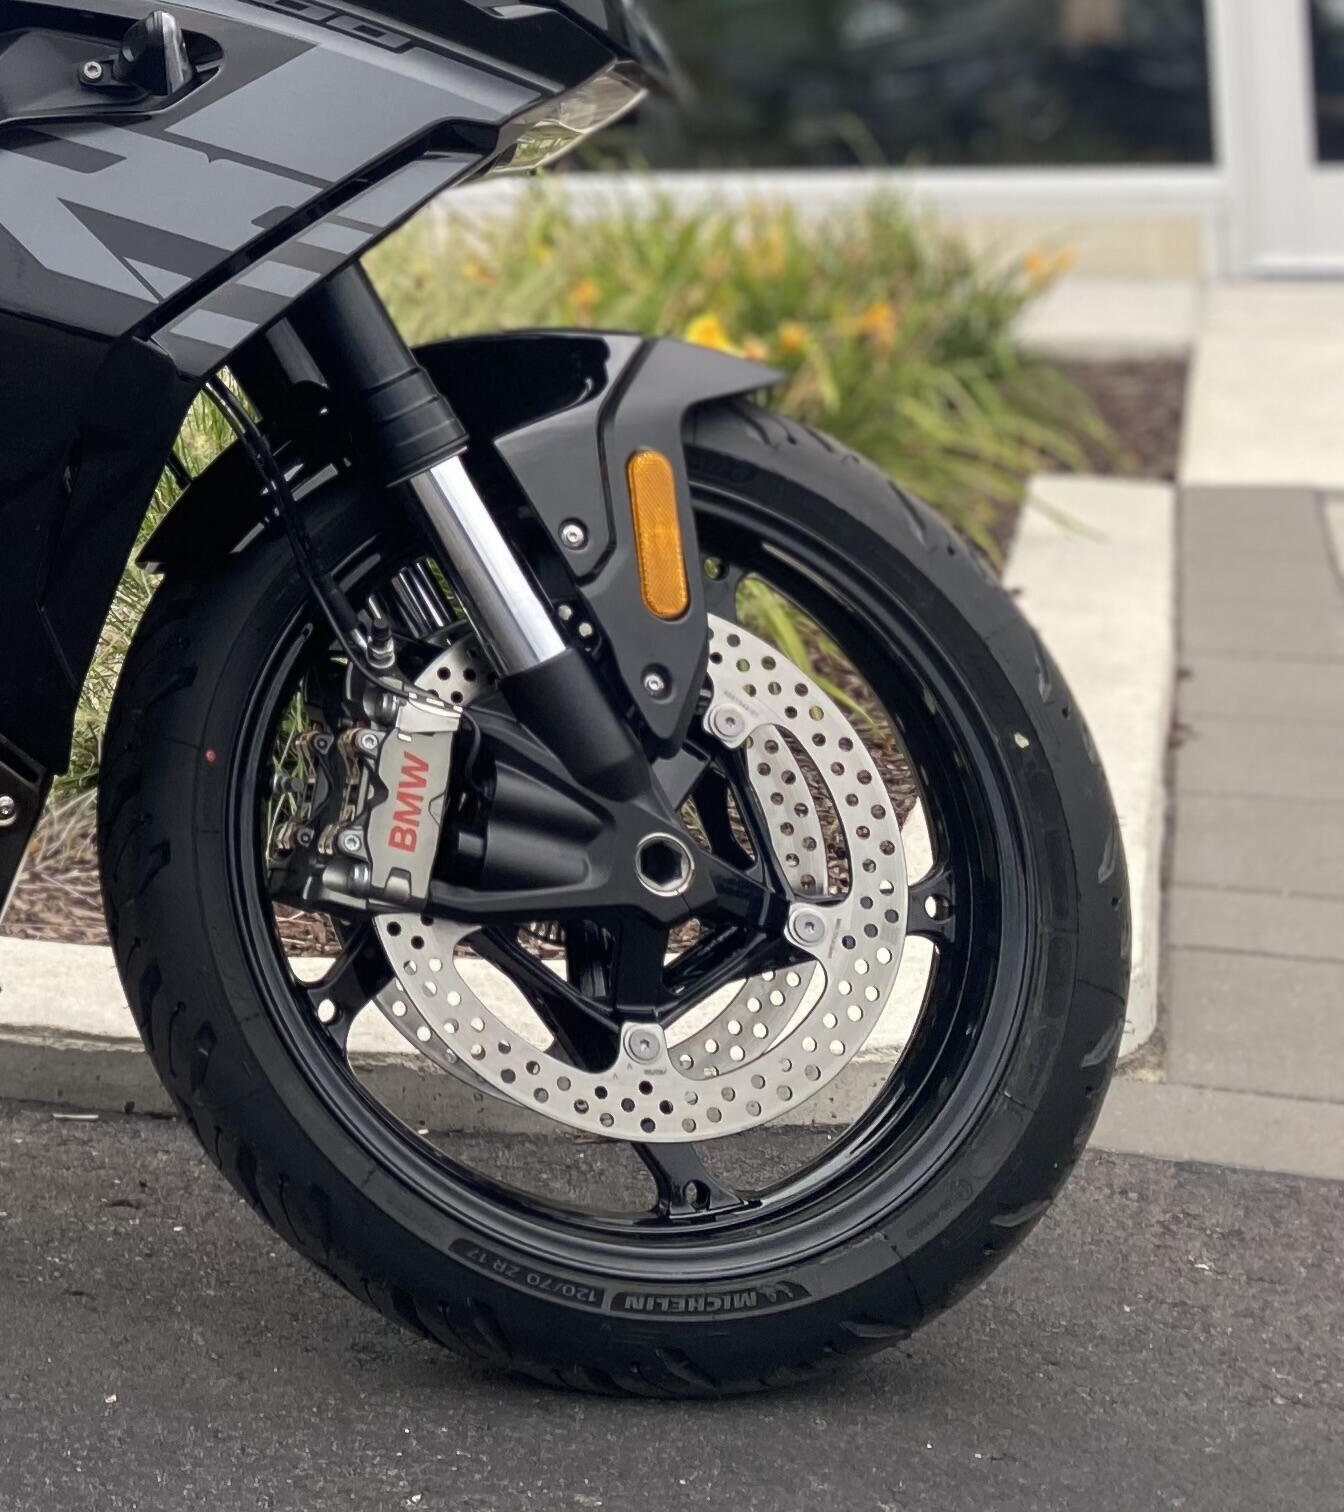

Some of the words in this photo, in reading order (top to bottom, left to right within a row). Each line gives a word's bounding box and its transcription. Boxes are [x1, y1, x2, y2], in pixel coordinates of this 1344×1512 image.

[388, 751, 429, 853] BMW
[526, 1273, 597, 1303] 120/70
[623, 1291, 758, 1312] MICHELIN
